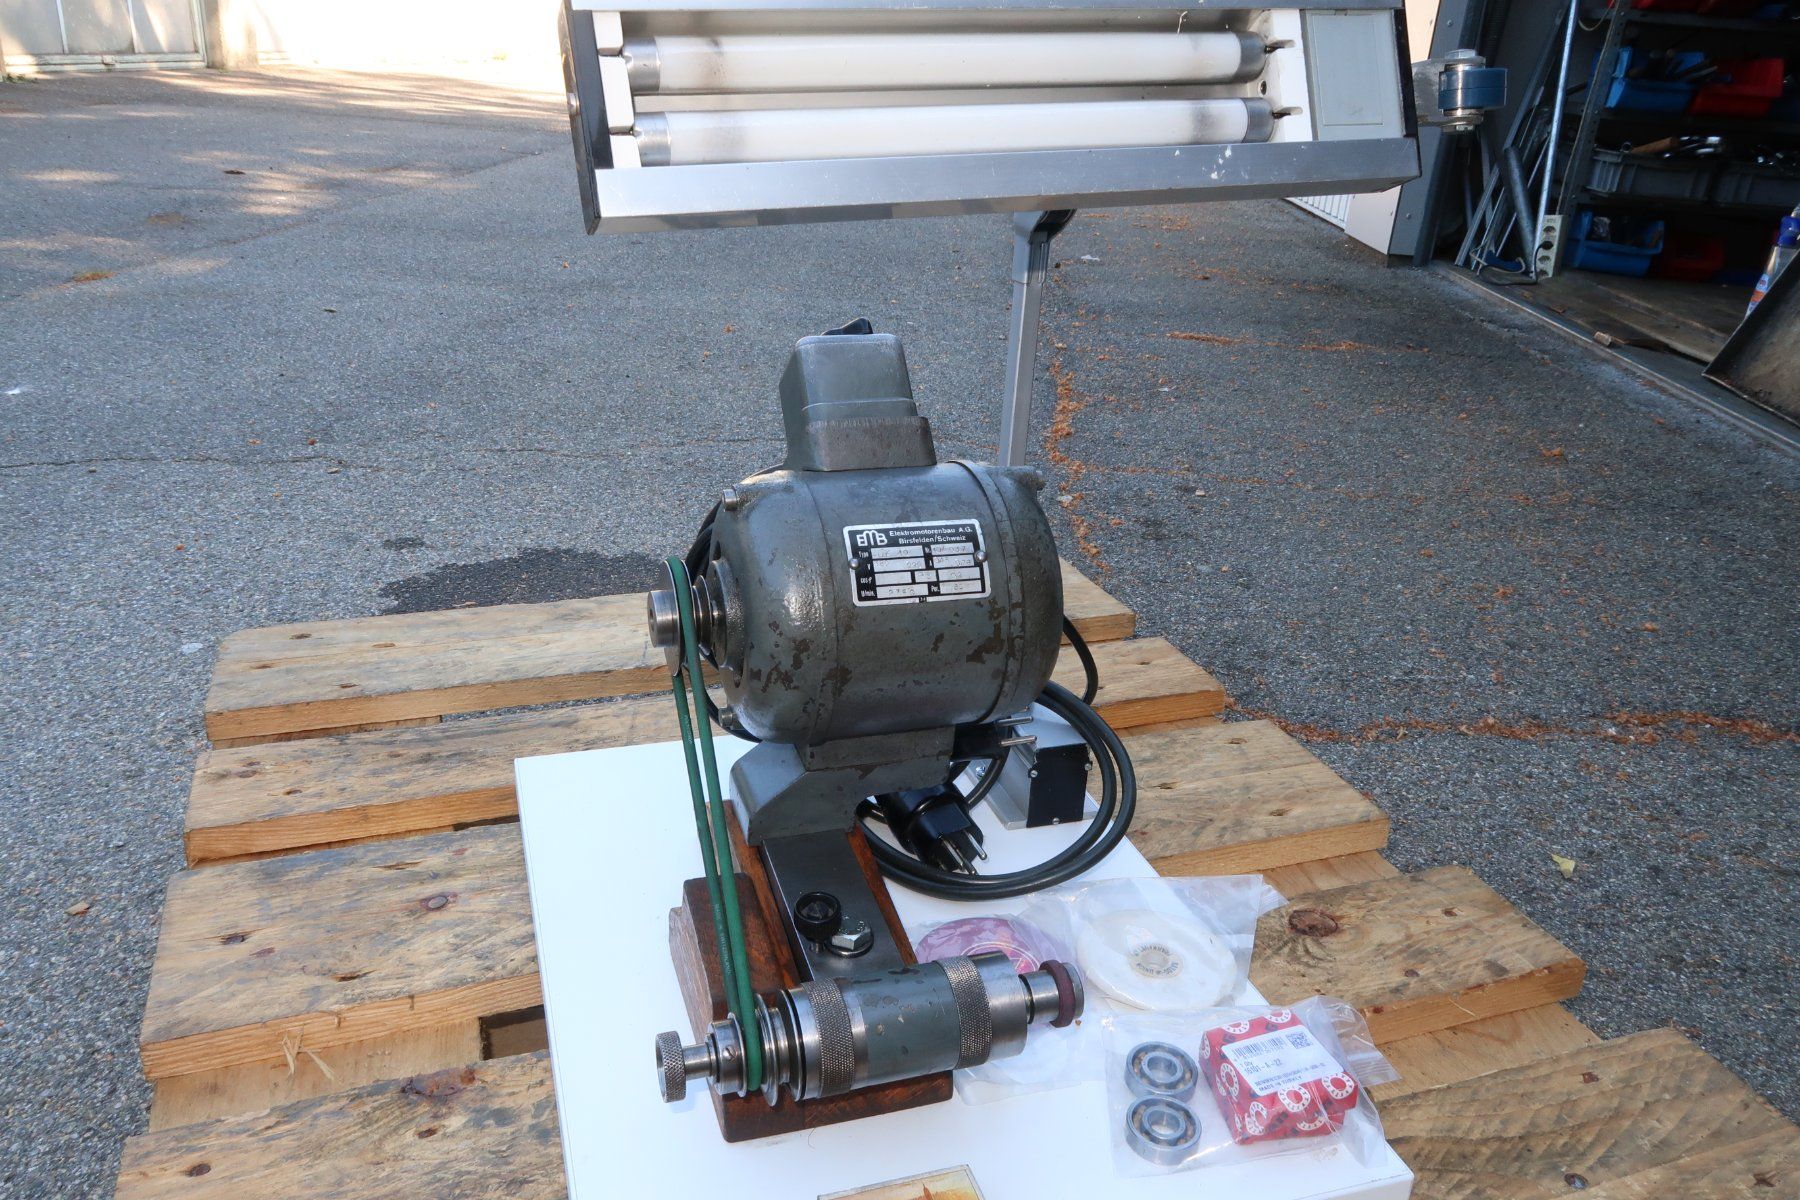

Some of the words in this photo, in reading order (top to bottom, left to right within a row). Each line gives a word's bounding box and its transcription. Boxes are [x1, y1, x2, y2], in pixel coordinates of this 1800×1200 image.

[889, 527, 956, 537] Elektromotorenbau
[856, 529, 888, 547] EMB
[898, 535, 967, 545] Birsfelden/Schweiz
